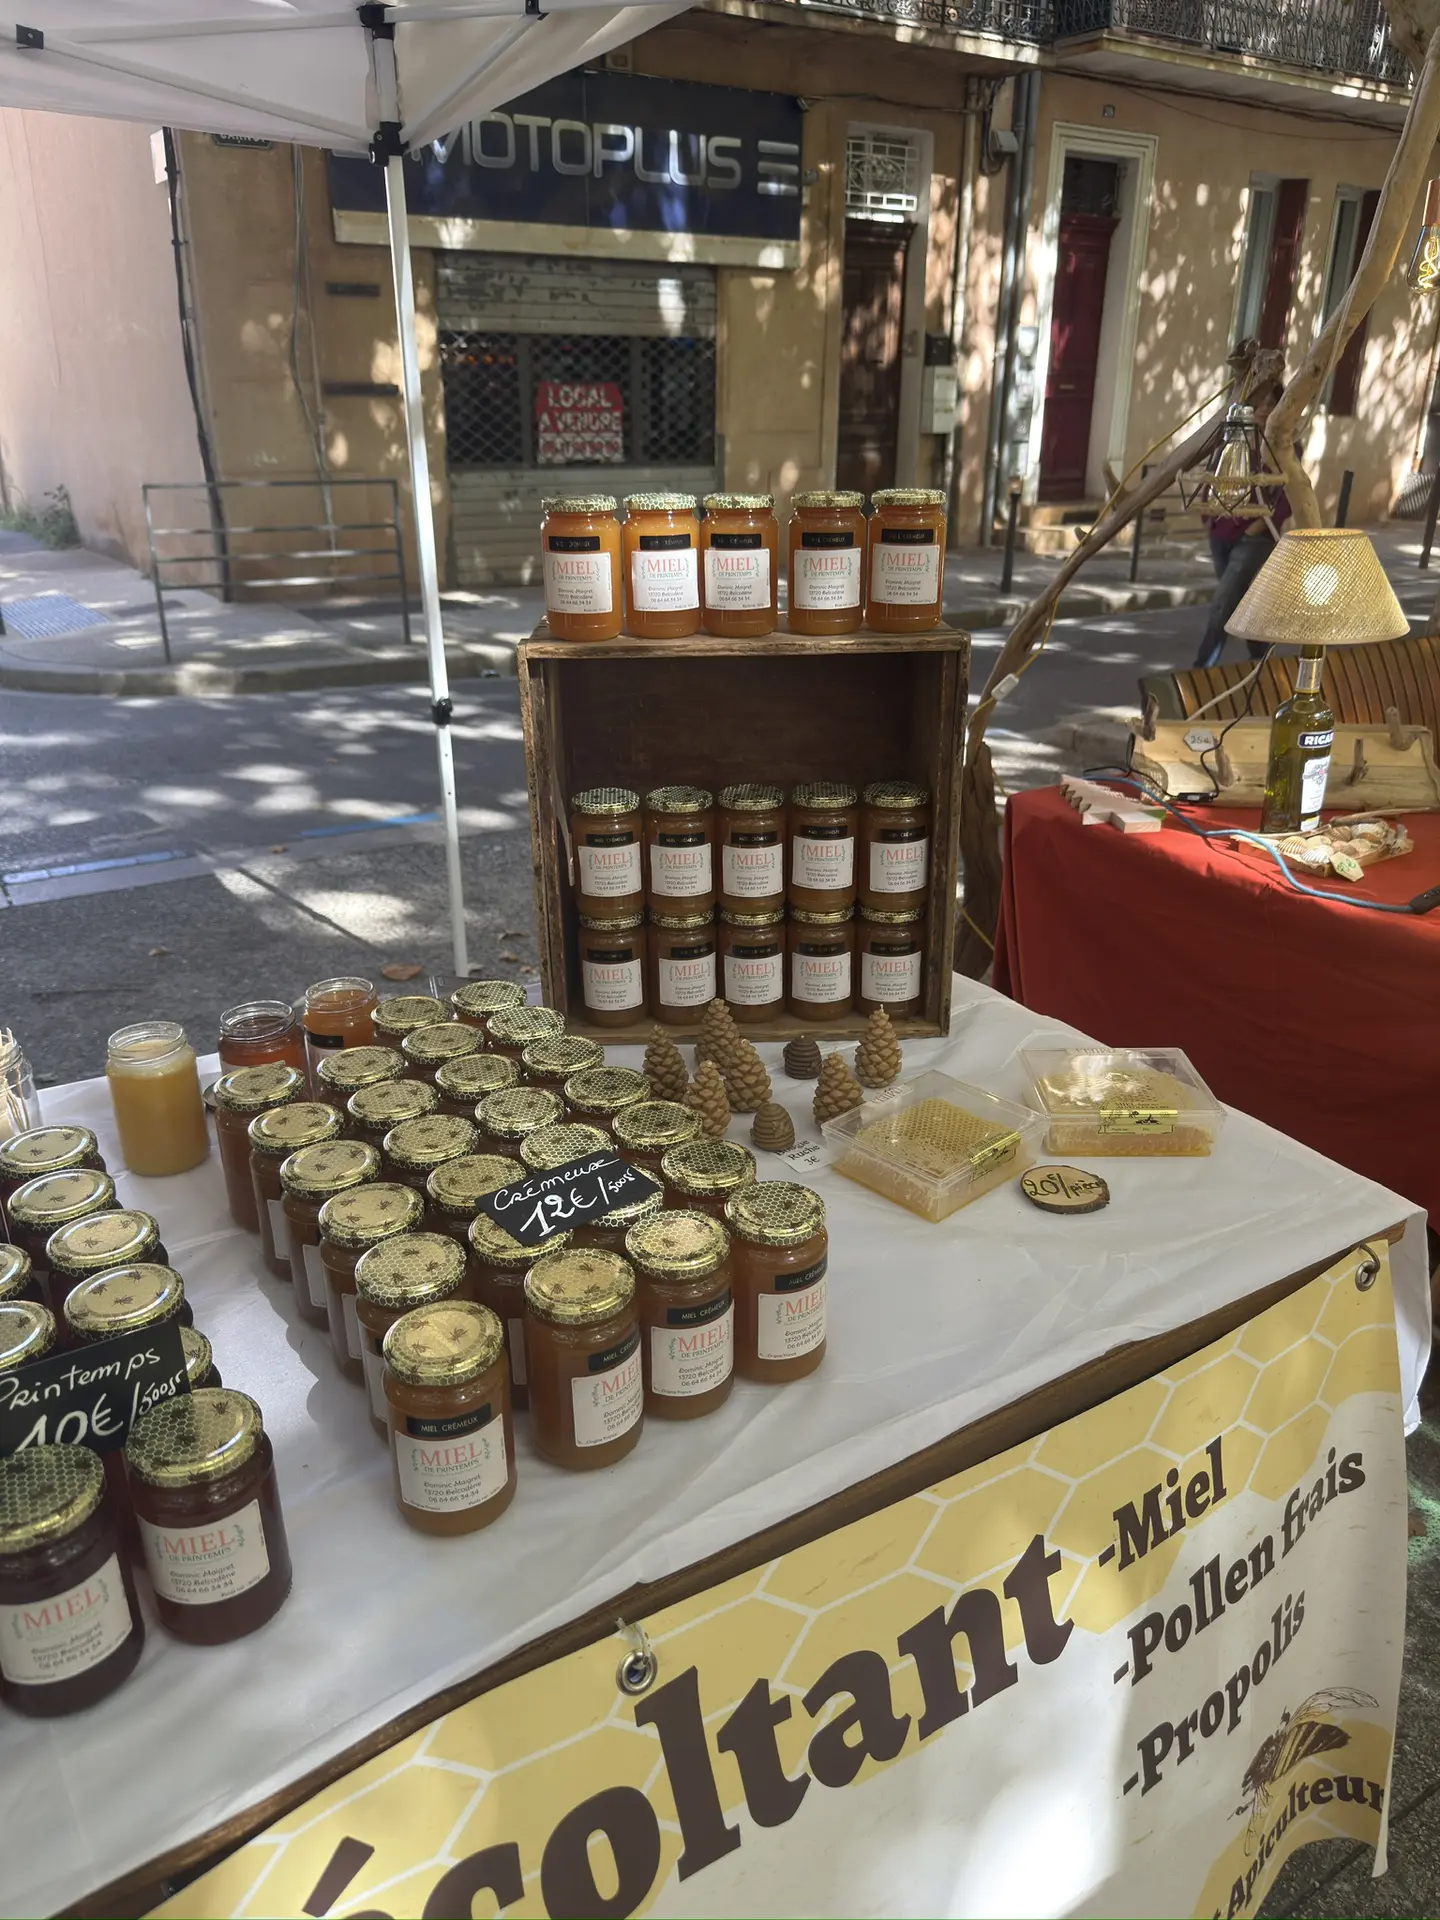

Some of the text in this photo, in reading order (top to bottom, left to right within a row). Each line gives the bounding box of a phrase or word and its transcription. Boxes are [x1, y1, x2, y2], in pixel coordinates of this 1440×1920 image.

[548, 385, 612, 408] LOCAL
[647, 558, 685, 572] MIEL
[716, 557, 754, 571] MIEL
[809, 557, 848, 571] MIEL
[886, 553, 926, 567] MIEL
[557, 560, 595, 575] MIEL
[806, 845, 842, 857] MIEL
[886, 848, 921, 860] MIEL
[594, 852, 629, 865] MIEL
[665, 853, 699, 865] MIEL
[735, 853, 772, 865] MIEL
[674, 964, 707, 977] MIEL
[737, 963, 772, 975] MIEL
[805, 962, 839, 973] MIEL
[875, 961, 910, 973] MIEL
[594, 969, 628, 980] MIEL
[788, 1144, 821, 1160] Ruche
[804, 1155, 820, 1166] 3€
[785, 1282, 826, 1316] MIEL
[677, 1323, 726, 1352] MIEL
[692, 1341, 724, 1357] PRINTEMPS
[603, 1353, 618, 1362] MIEL
[700, 1376, 707, 1384] 66
[442, 1416, 478, 1431] CRÉMEUX
[607, 1423, 616, 1431] 06
[419, 1442, 482, 1466] MIEL
[437, 1459, 479, 1473] PRINTEMPS
[454, 1474, 481, 1487] Maigret
[446, 1482, 481, 1495] Belcodène
[1098, 1434, 1227, 1572] -Miel
[163, 1529, 235, 1555] MIEL
[182, 1547, 231, 1562] PRINTEMPS
[202, 1564, 235, 1577] Maigret
[1113, 1446, 1366, 1687] -Pollen frais
[194, 1571, 236, 1586] Belcodène
[23, 1587, 101, 1631] MIEL
[1121, 1588, 1305, 1799] -Propolis
